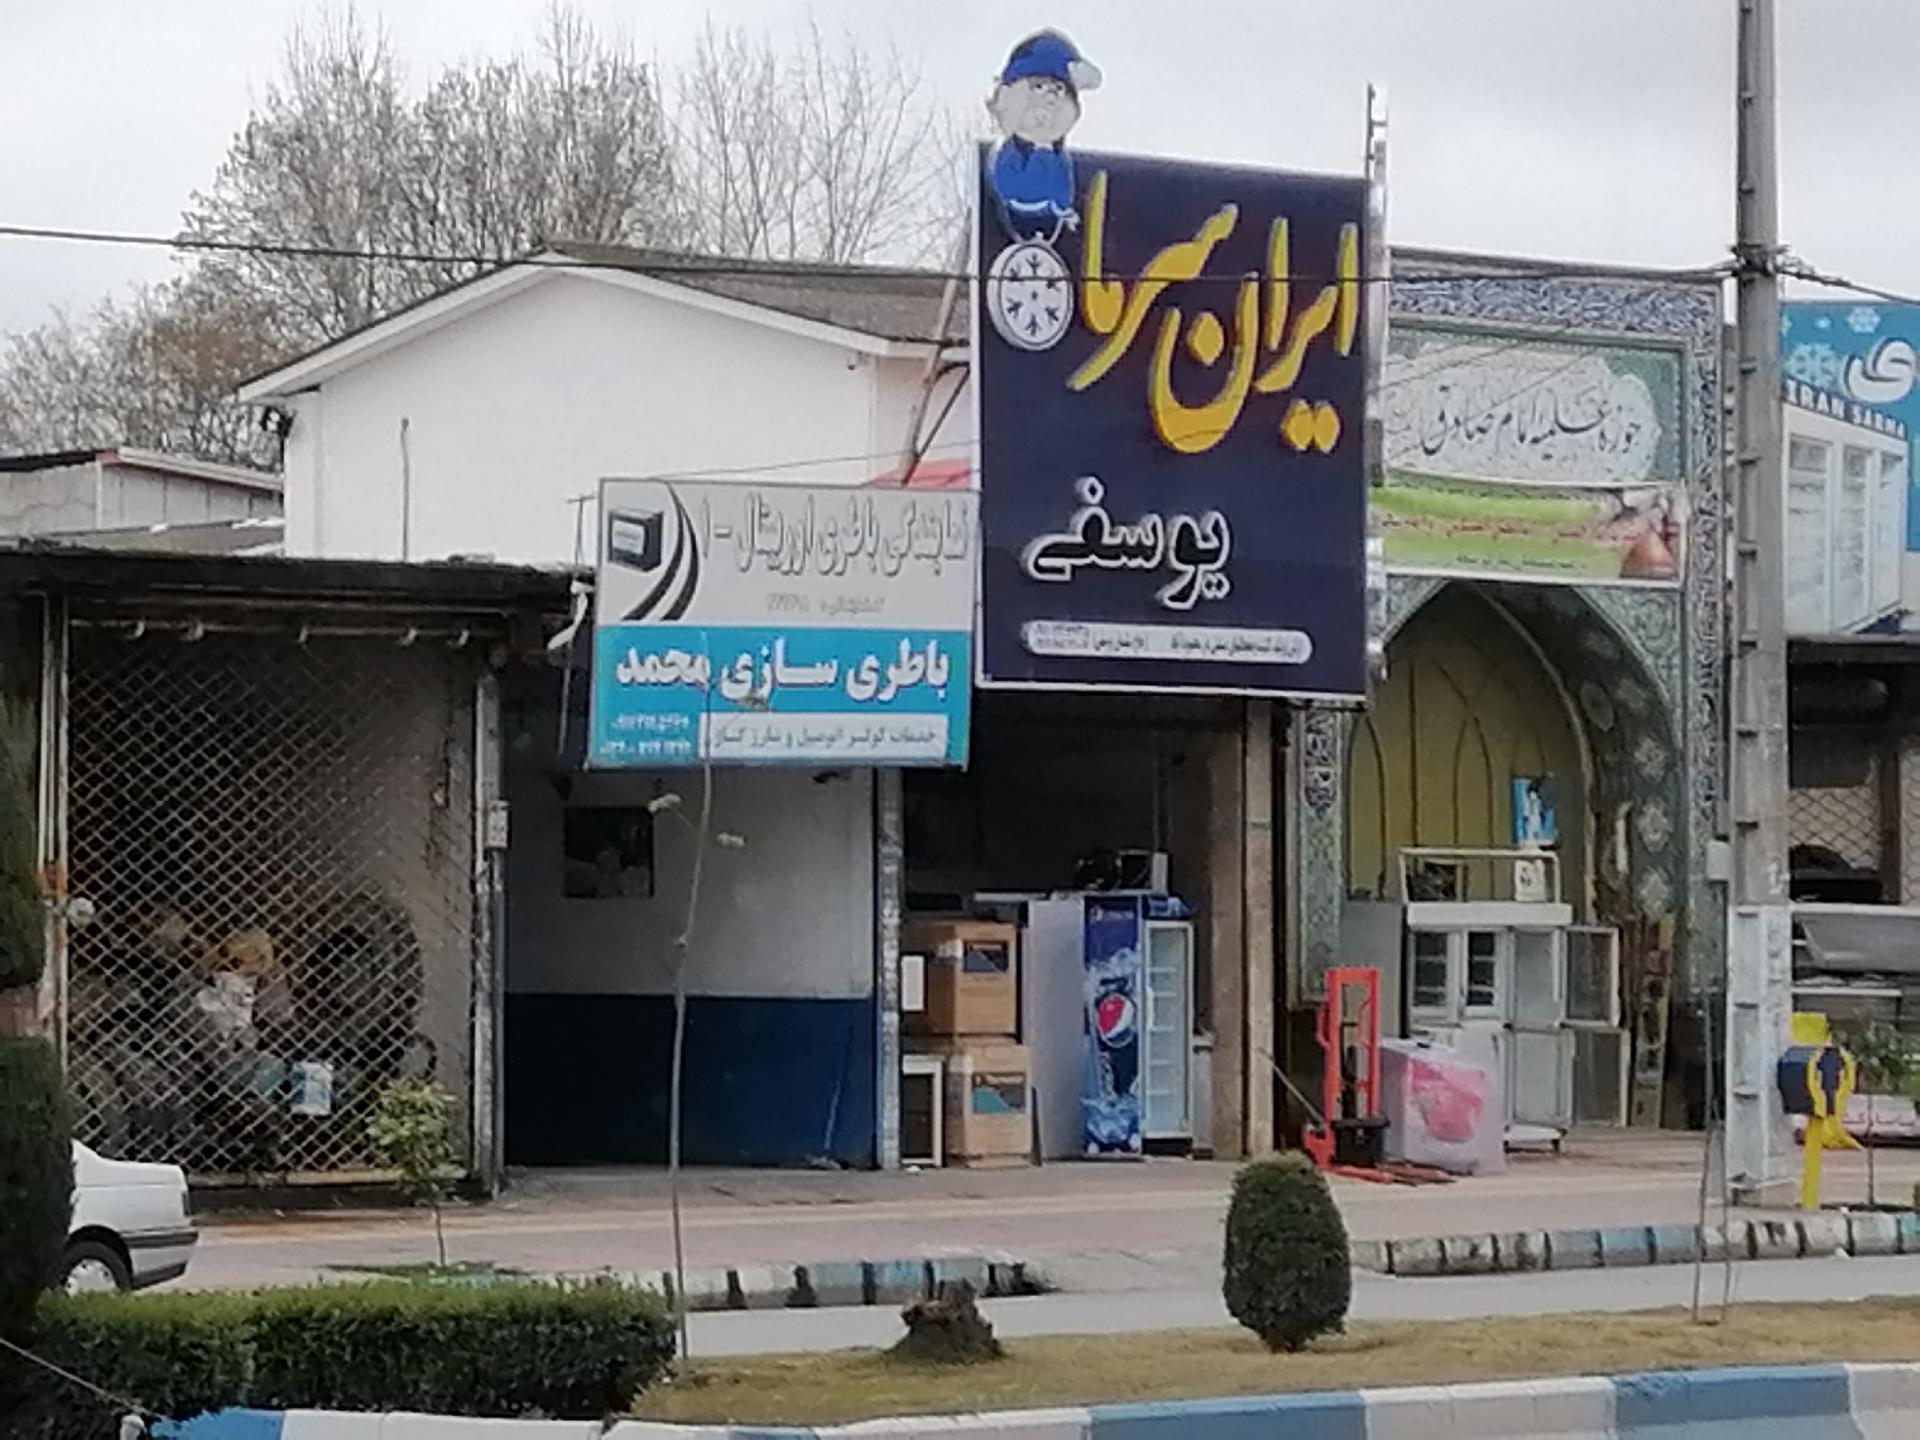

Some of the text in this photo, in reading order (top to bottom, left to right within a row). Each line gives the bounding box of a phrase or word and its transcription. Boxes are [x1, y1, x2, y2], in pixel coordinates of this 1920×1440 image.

[1065, 168, 1361, 455] ایران سرما
[1784, 378, 1845, 420] IRAN
[1022, 475, 1231, 609] یوسفی
[614, 636, 950, 703] باطری سازی محمد
